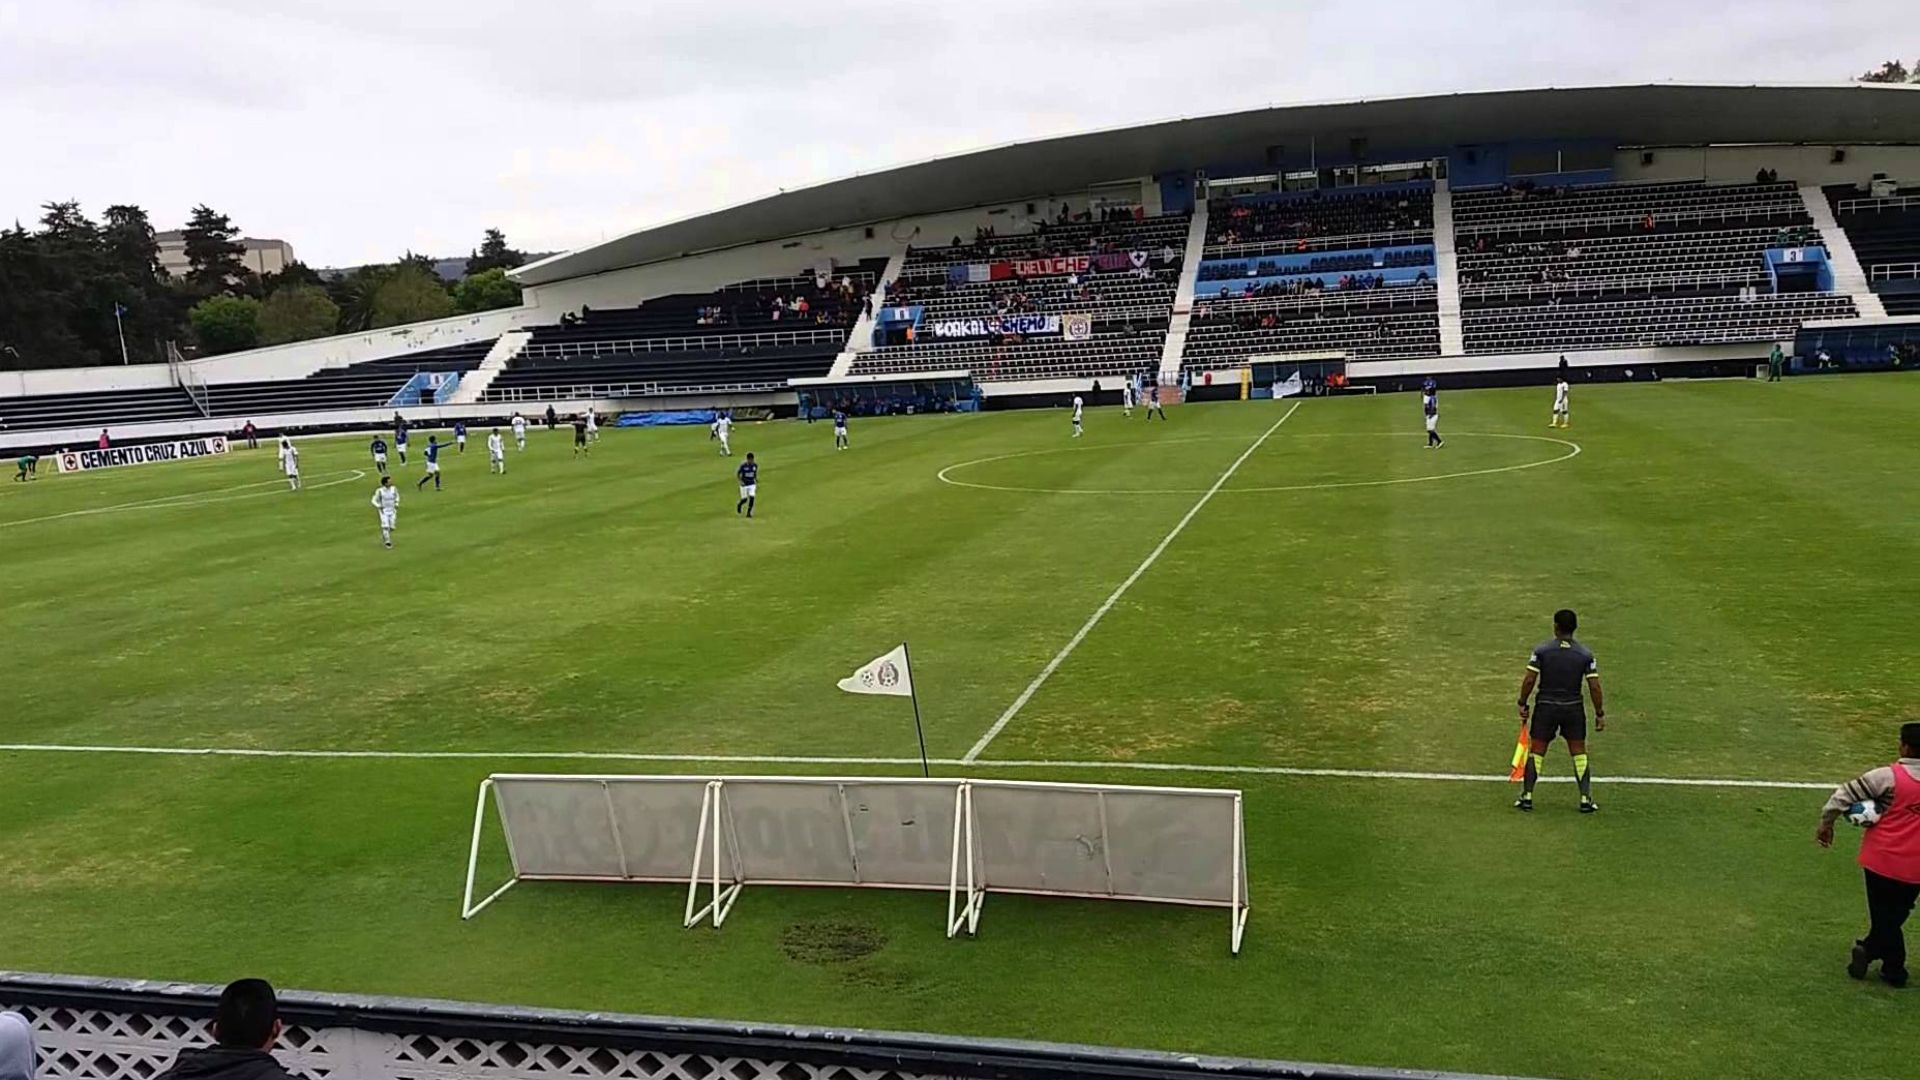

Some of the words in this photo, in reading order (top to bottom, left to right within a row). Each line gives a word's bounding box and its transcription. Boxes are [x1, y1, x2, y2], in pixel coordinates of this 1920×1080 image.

[1790, 251, 1797, 262] 3
[81, 447, 144, 469] CEMENTO
[145, 444, 177, 463] CRUZ
[180, 441, 211, 458] AZUL
